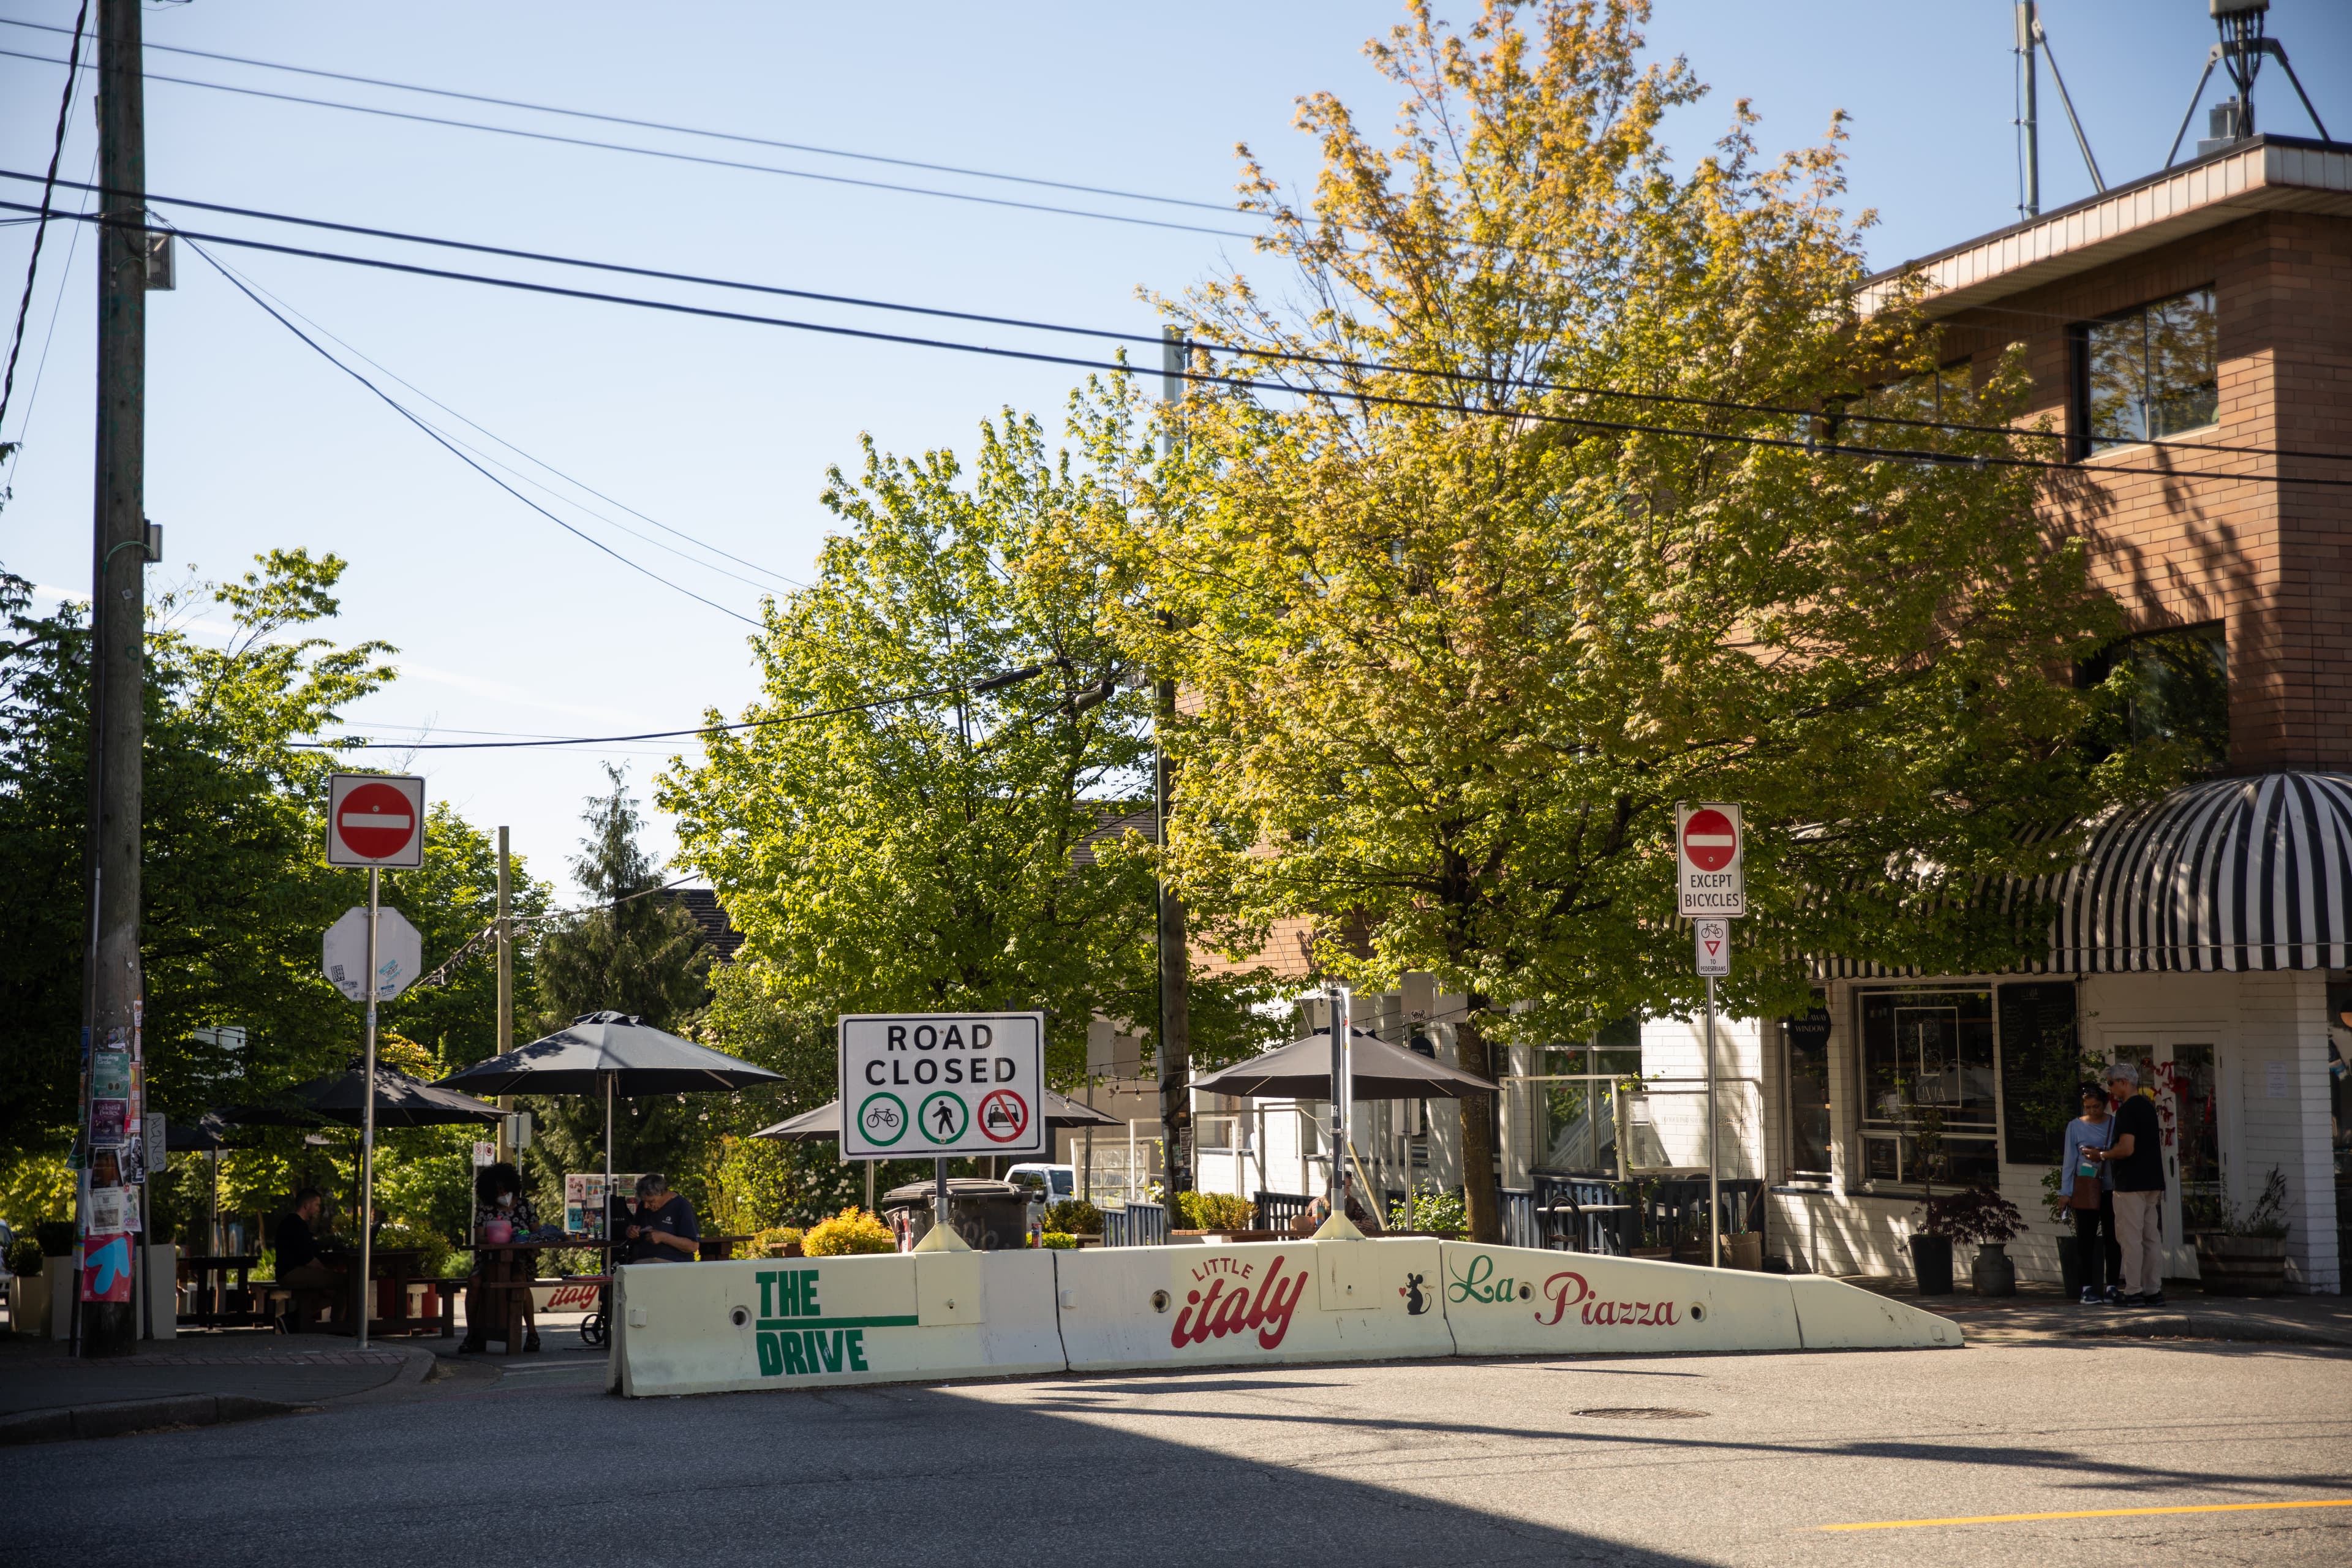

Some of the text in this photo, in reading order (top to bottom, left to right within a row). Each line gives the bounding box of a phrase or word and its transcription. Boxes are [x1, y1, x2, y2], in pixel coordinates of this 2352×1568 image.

[1691, 874, 1732, 888] EXCEPT
[1685, 893, 1740, 907] BICYCLES
[888, 1024, 993, 1051] ROAD
[865, 1057, 1016, 1086] CLOSED
[1916, 1086, 1946, 1101] LIVIA
[1191, 1257, 1254, 1282] LITTLE
[1447, 1250, 1518, 1304] La
[547, 1285, 600, 1310] italy
[755, 1270, 821, 1317] THE
[1171, 1255, 1309, 1350] italy
[1534, 1271, 1683, 1327] Piazza
[756, 1329, 869, 1376] DRIVE
